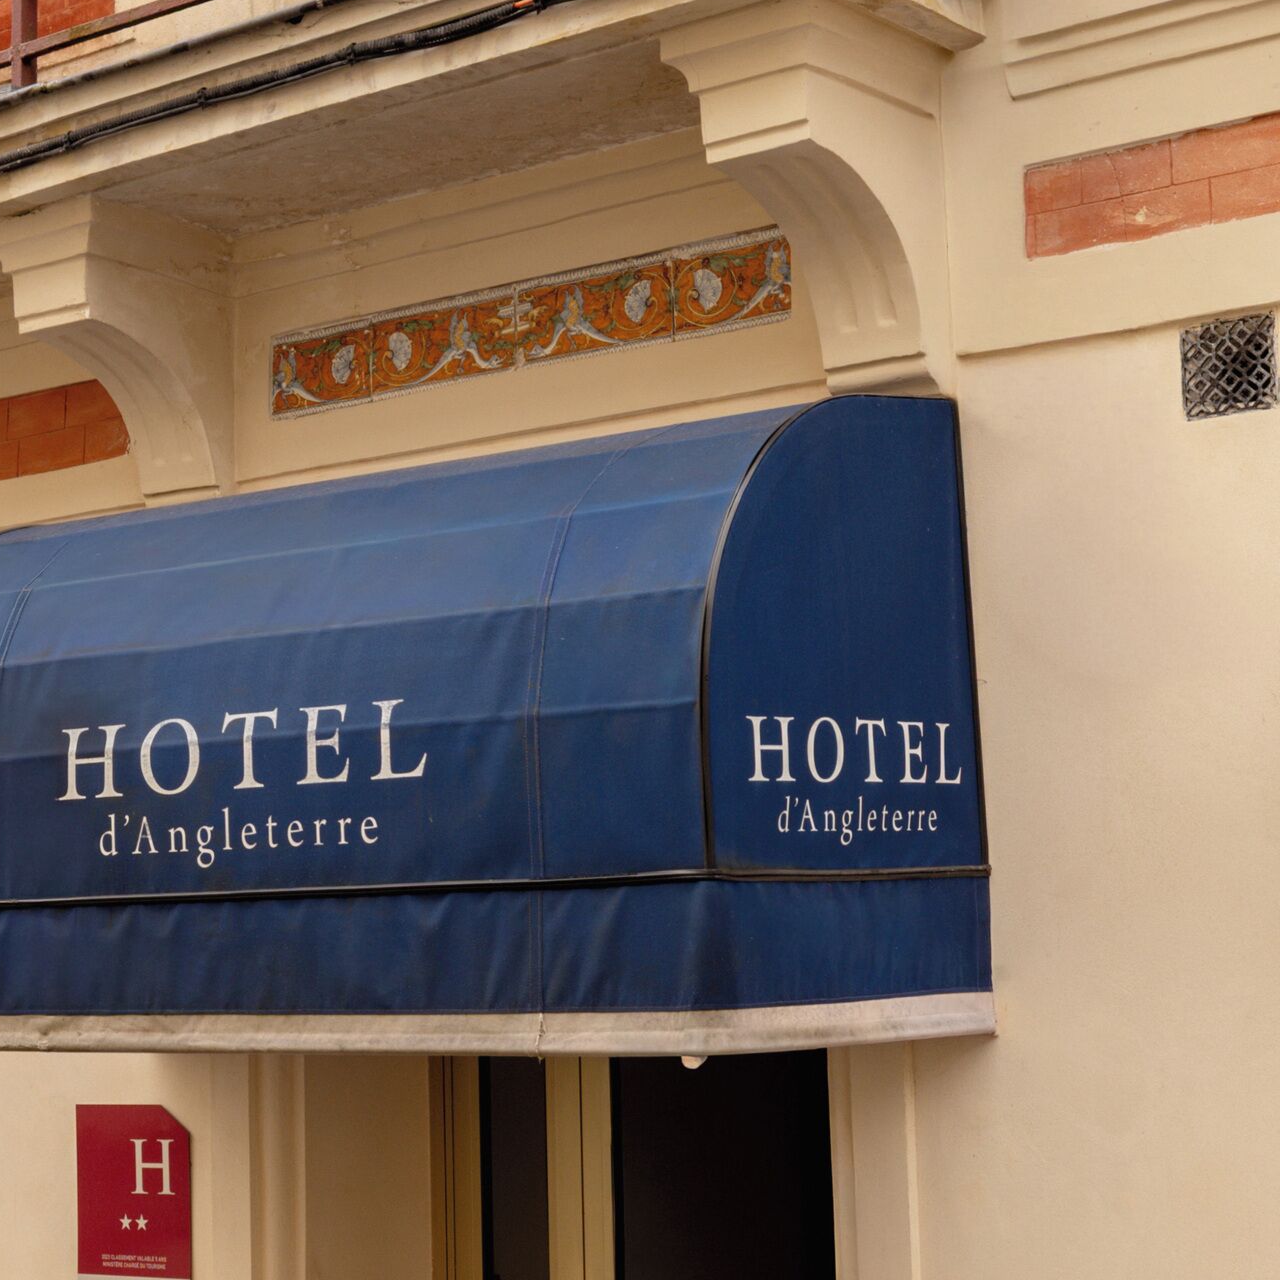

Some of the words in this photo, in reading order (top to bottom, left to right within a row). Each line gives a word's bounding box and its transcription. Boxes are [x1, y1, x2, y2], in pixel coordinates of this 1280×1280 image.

[56, 699, 428, 801] HOTEL
[745, 715, 962, 784] HOTEL
[99, 807, 379, 869] d'Angleterre
[777, 795, 938, 846] d'Angleterre
[129, 1138, 176, 1196] H
